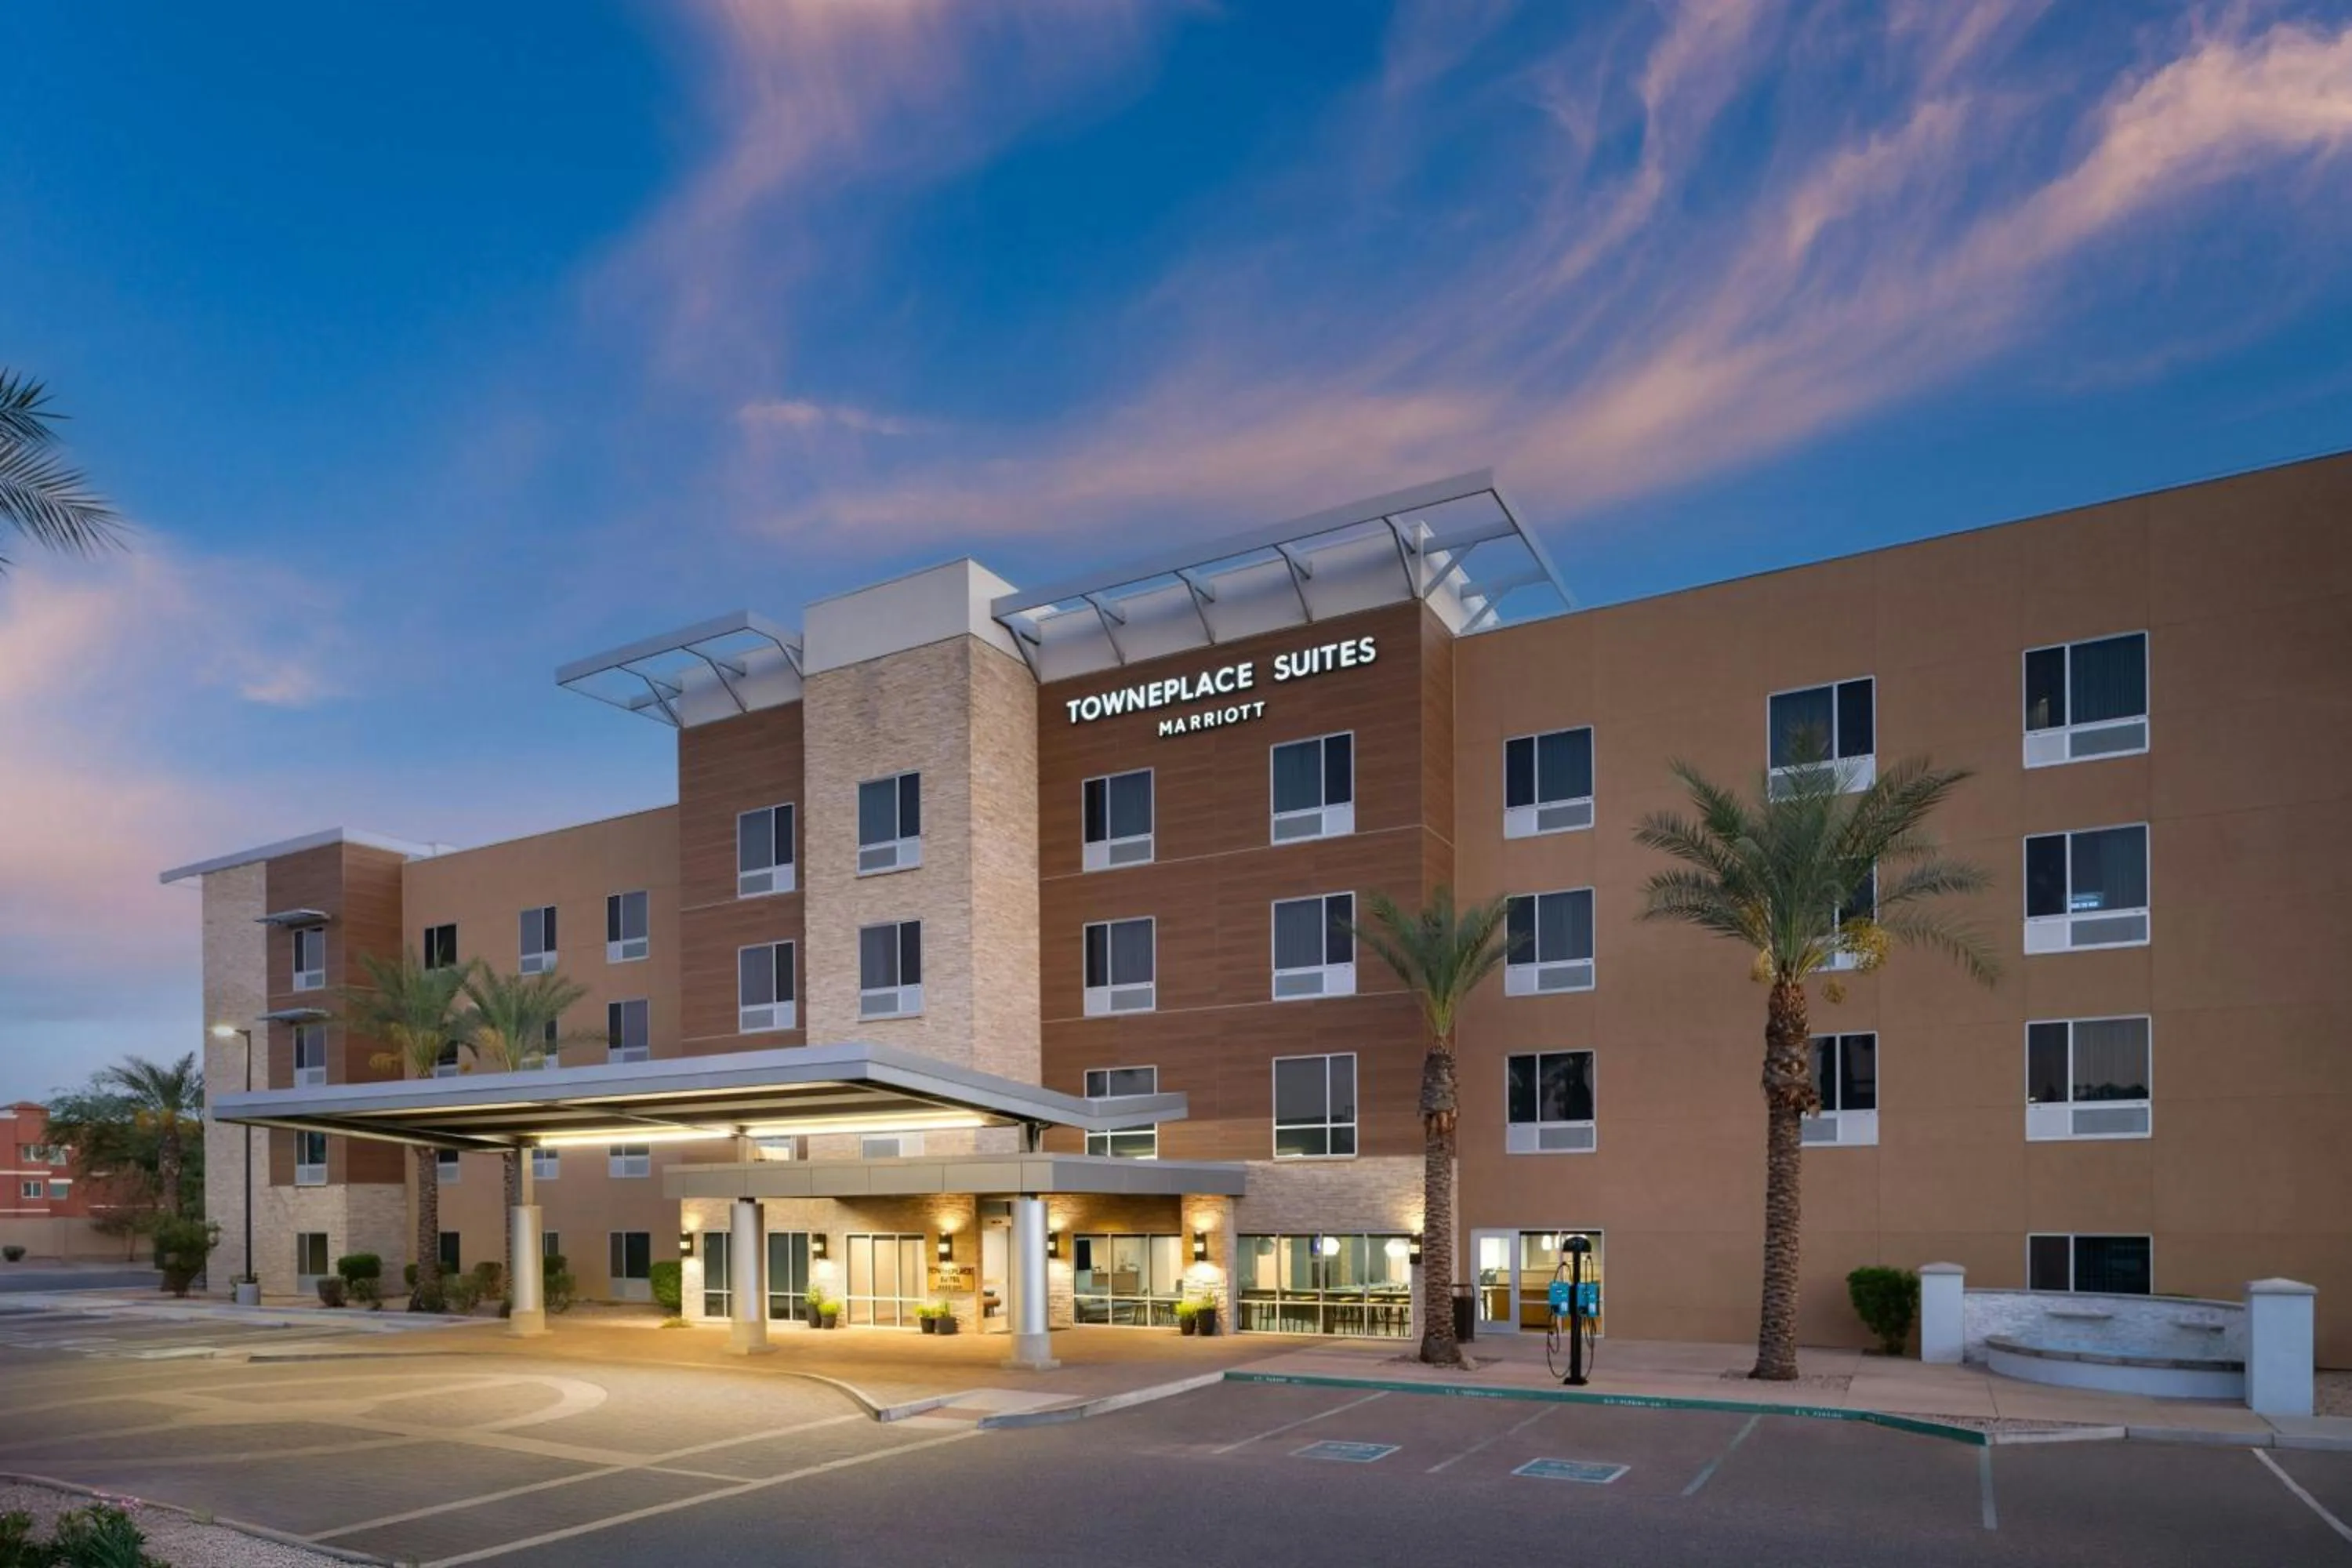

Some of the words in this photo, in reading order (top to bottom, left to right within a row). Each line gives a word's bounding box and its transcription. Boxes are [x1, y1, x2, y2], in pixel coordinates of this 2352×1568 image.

[1066, 662, 1254, 723] TOWNEPLACE
[1273, 637, 1376, 681] SUITES
[1159, 702, 1265, 736] MARRIOTT
